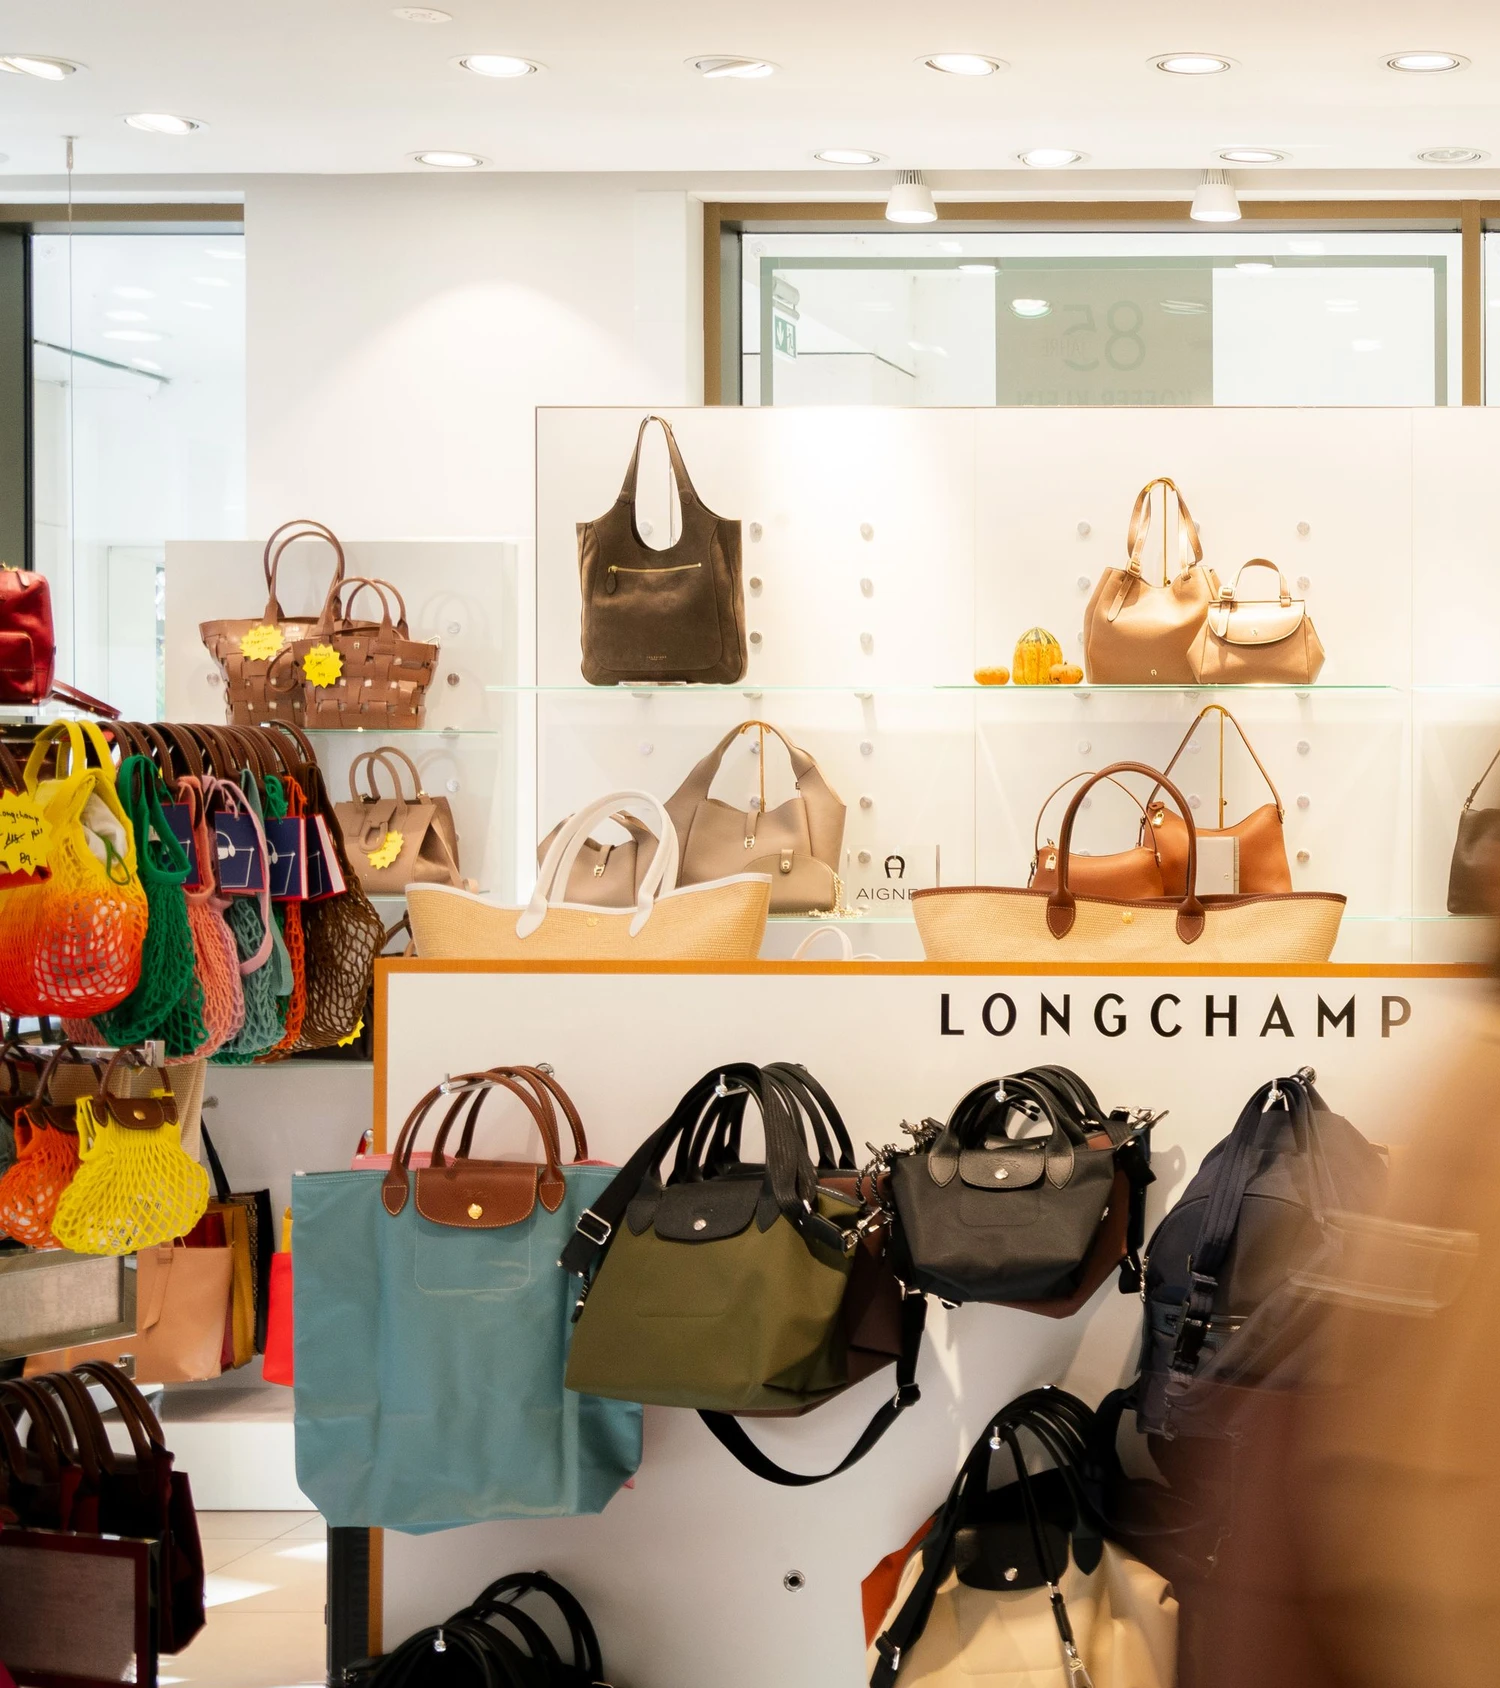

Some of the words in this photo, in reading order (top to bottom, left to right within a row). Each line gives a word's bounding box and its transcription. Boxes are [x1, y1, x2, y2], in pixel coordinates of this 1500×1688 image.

[0, 810, 40, 826] ongchamp
[856, 887, 918, 901] AIGNE
[940, 992, 1412, 1039] LONGCHAMP
